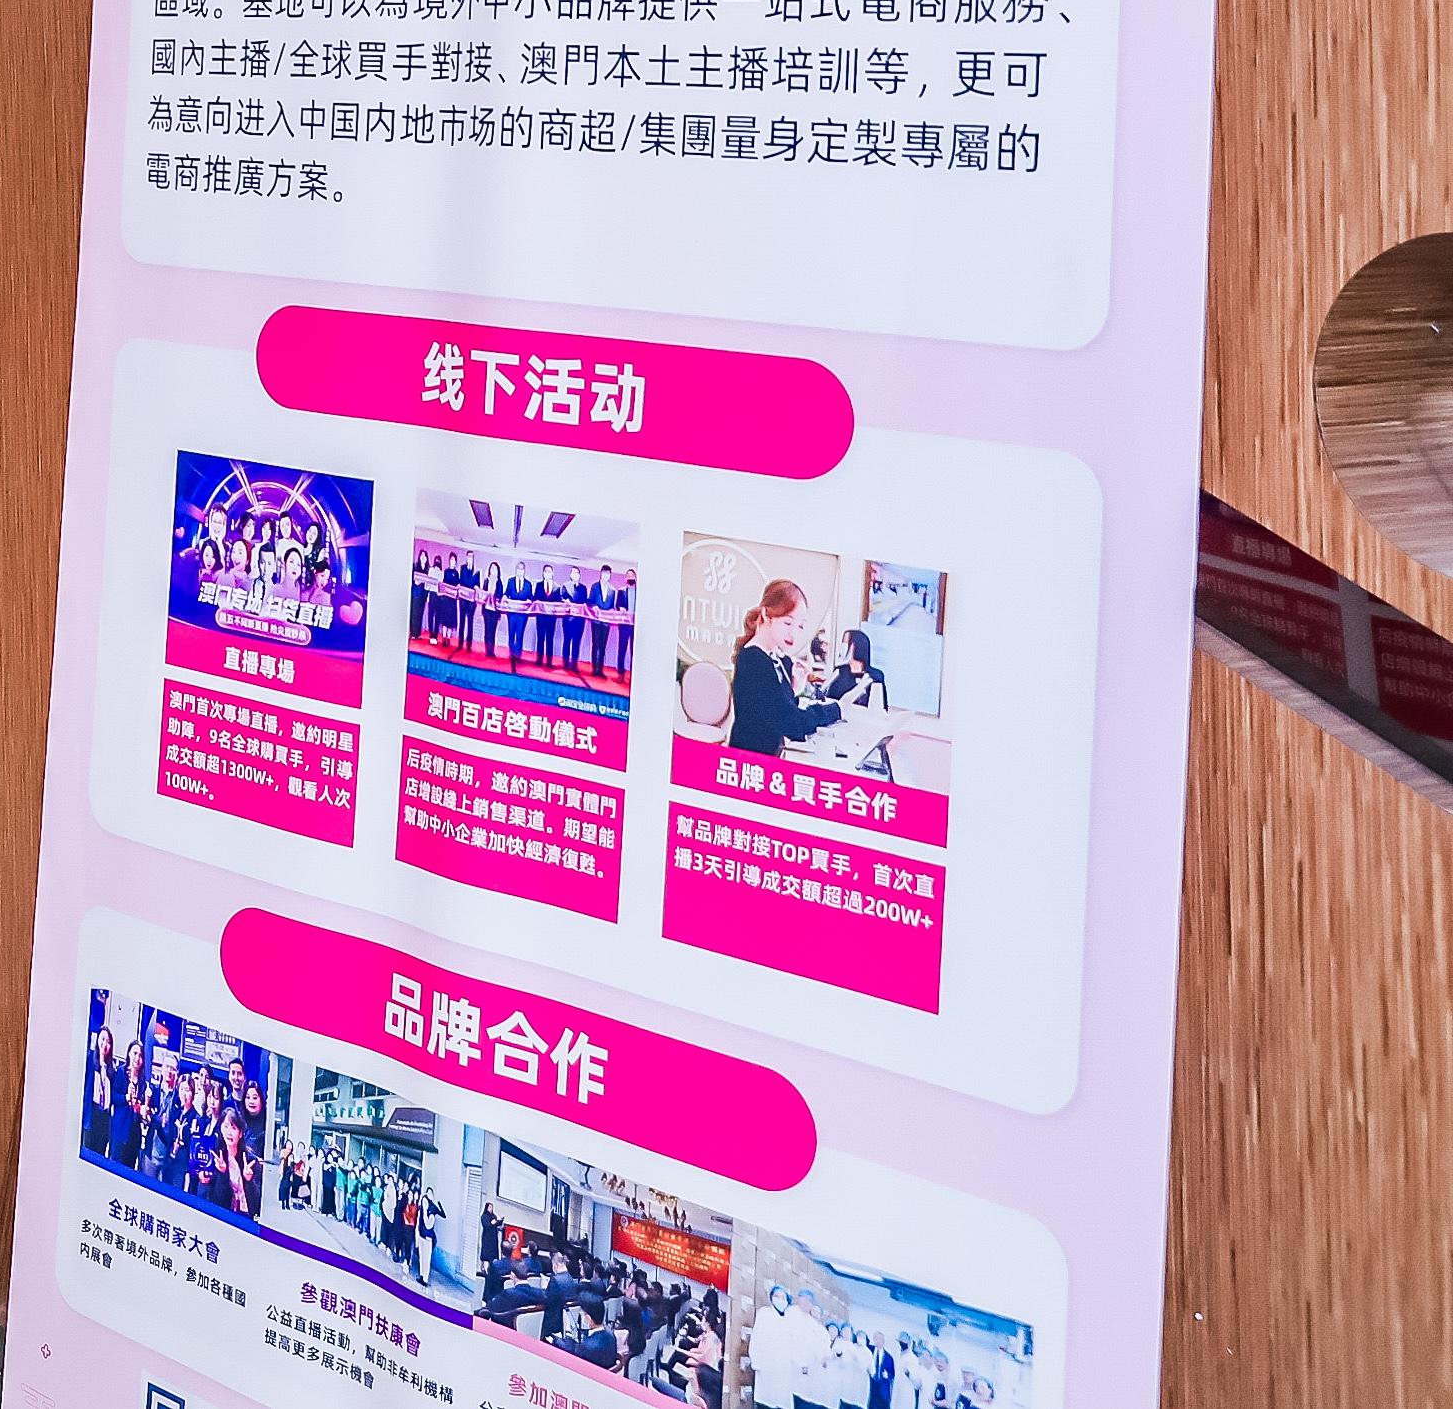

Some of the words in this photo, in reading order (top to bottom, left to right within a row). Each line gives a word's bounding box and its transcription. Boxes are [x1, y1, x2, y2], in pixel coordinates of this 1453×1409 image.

[145, 152, 345, 203] 電商推廣方案。
[420, 341, 646, 434] 线下活动
[223, 646, 296, 684] 直播專場
[383, 971, 609, 1104] 品牌合作
[108, 1197, 221, 1265] 全球購商家大會
[300, 1281, 422, 1358] 參觀澳門扶康會
[263, 1327, 376, 1390] 提高更多展示機會
